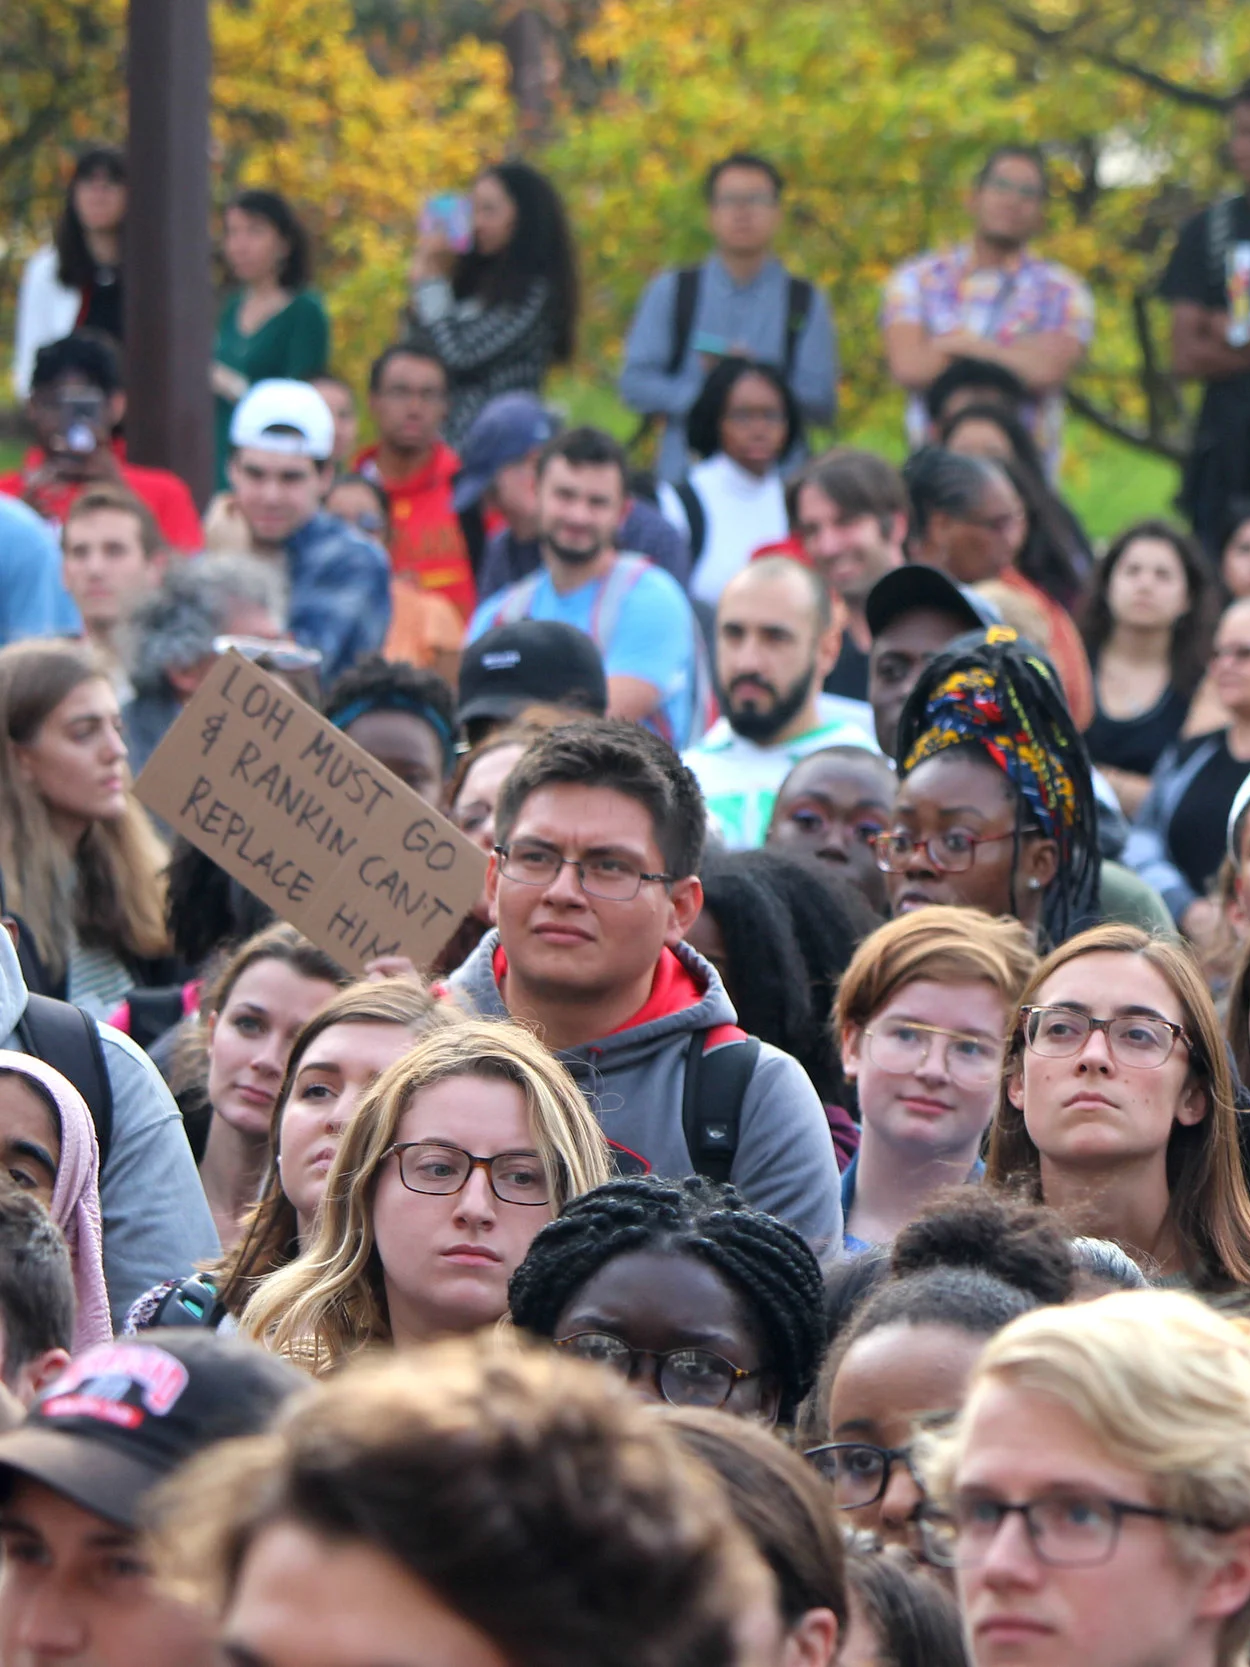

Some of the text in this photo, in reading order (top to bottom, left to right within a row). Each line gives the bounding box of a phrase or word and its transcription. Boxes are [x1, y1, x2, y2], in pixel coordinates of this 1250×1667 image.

[179, 774, 315, 902] REPLACE
[200, 711, 227, 757] &
[230, 740, 358, 858] RANKIN
[219, 664, 457, 872] LOH MUST GO
